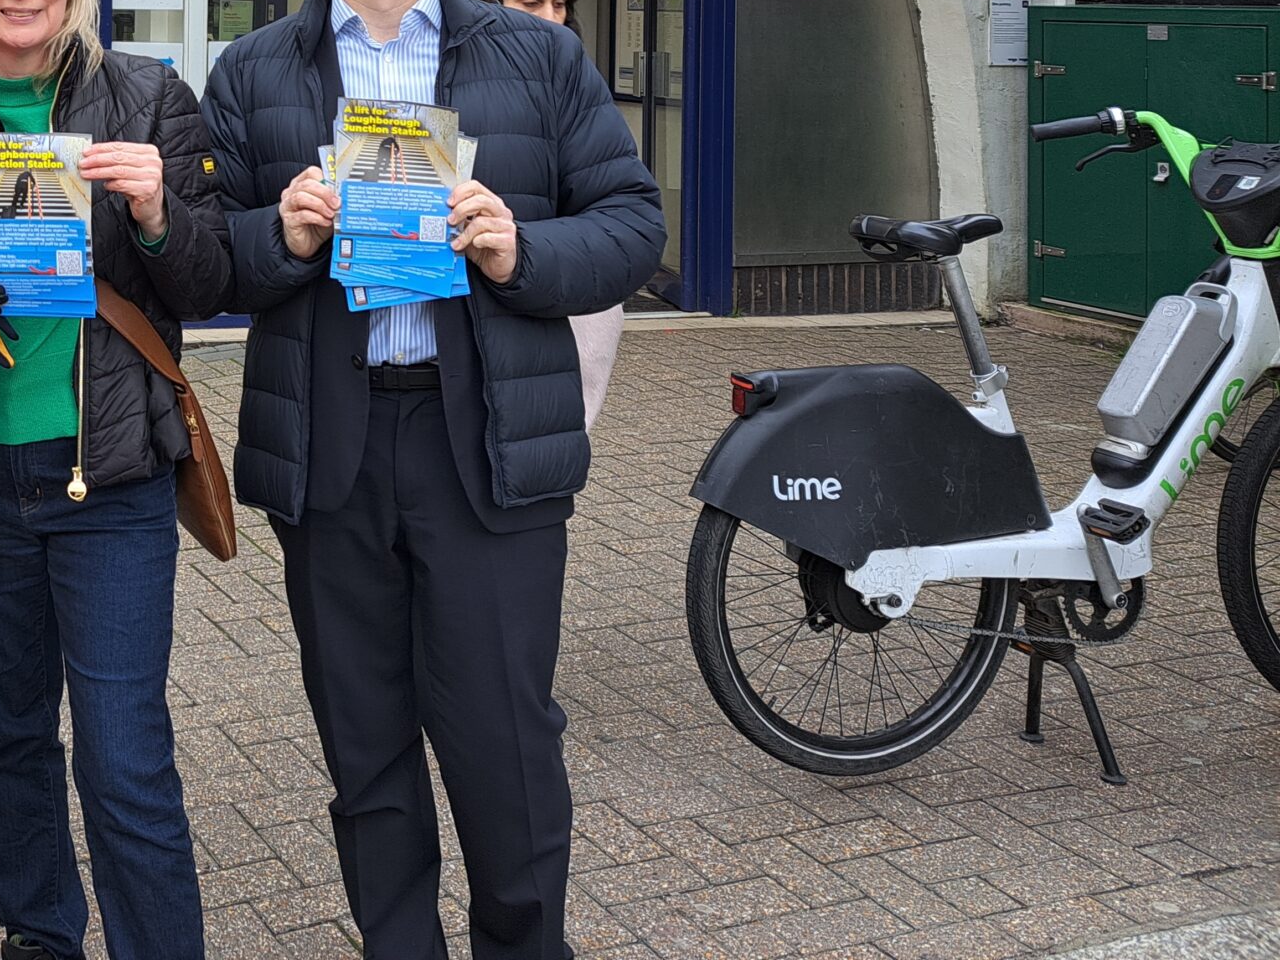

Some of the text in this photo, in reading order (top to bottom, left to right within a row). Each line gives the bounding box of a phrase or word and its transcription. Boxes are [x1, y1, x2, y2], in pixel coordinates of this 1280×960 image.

[344, 106, 388, 115] A lift for
[343, 115, 421, 128] Loughborough
[343, 124, 430, 137] Junction Station
[8, 141, 23, 149] for
[27, 160, 64, 168] Station
[772, 474, 843, 501] Lime
